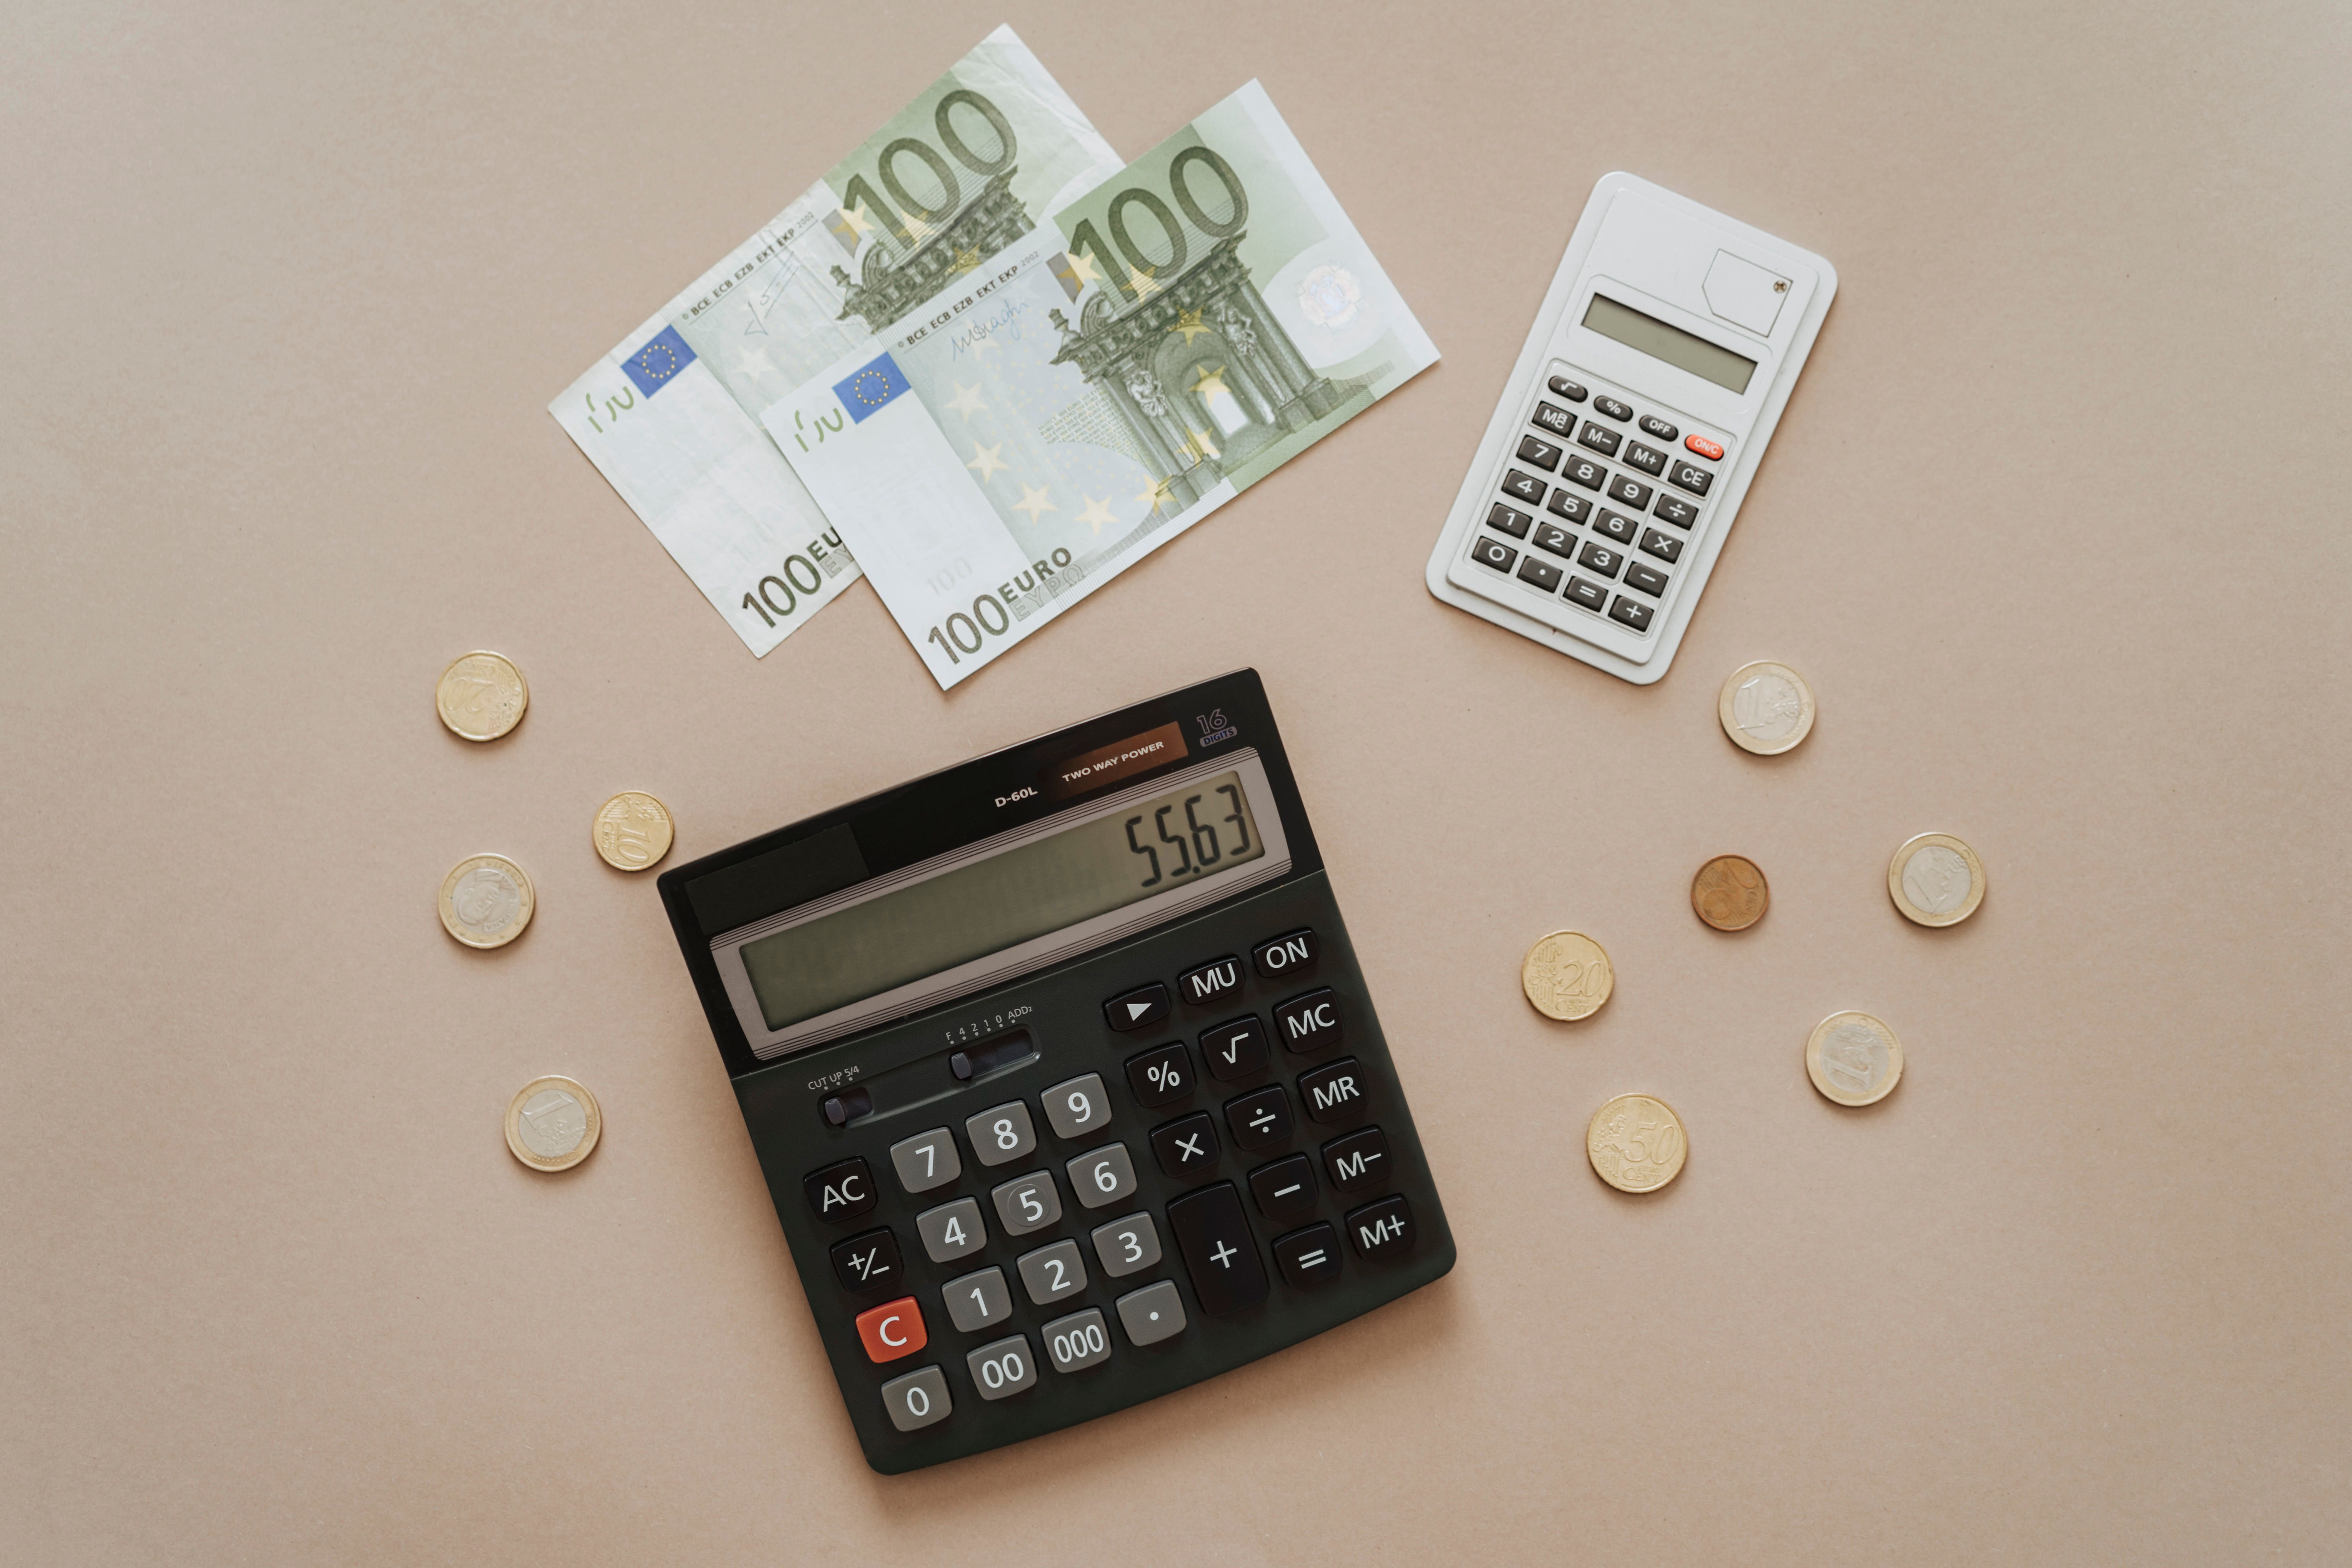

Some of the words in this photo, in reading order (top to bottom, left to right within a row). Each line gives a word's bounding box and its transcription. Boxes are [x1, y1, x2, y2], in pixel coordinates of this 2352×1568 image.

[843, 89, 1017, 250] 100
[1068, 145, 1249, 303] 100
[690, 297, 711, 316] BCE
[712, 279, 733, 298] ECB
[734, 263, 755, 281] EZB
[756, 245, 776, 263] EKT
[776, 228, 795, 247] EKP
[797, 211, 815, 229] 2002
[906, 327, 928, 345] BCE
[930, 311, 951, 330] ECB
[953, 296, 973, 314] EZB
[976, 281, 997, 298] EKT
[998, 265, 1018, 283] EKP
[1020, 250, 1039, 267] 2002
[1649, 419, 1671, 434] OFF
[1535, 444, 1549, 458] 7
[1694, 438, 1719, 455] ON/C
[1517, 480, 1532, 493] 4
[1577, 464, 1594, 479] 8
[1682, 468, 1704, 486] CE
[1563, 497, 1579, 513] 5
[1623, 483, 1639, 499] 9
[1507, 512, 1516, 526] 1
[1609, 517, 1625, 532] 6
[1548, 530, 1564, 548] 2
[1594, 550, 1611, 566] 3
[742, 554, 822, 628] 100
[928, 594, 1009, 664] 100
[997, 548, 1071, 604] EURO
[1196, 708, 1227, 735] 16
[1203, 728, 1234, 745] DIGITS
[1062, 767, 1091, 782] TWO
[1093, 757, 1118, 771] WAY
[1121, 741, 1164, 762] POWER
[995, 787, 1038, 808] D-60L
[617, 821, 651, 862] 10
[1125, 784, 1250, 888] 55.63
[1266, 937, 1308, 969] ON
[1191, 963, 1236, 997] MU
[1556, 960, 1606, 997] 20
[1287, 1003, 1335, 1038] MC
[1555, 1000, 1590, 1013] CENT
[946, 1032, 951, 1040] F
[971, 1023, 978, 1032] 2
[808, 1077, 828, 1090] CUT
[829, 1072, 842, 1082] UP
[844, 1065, 859, 1077] 5/4
[1313, 1076, 1360, 1109] MR
[1068, 1092, 1091, 1123] 9
[993, 1119, 1018, 1150] 8
[1624, 1122, 1679, 1165] 50
[915, 1145, 934, 1177] 7
[1094, 1161, 1117, 1192] 6
[823, 1175, 865, 1212] AC
[1019, 1189, 1043, 1221] 5
[944, 1216, 966, 1245] 4
[1359, 1215, 1405, 1249] M+
[1118, 1232, 1142, 1263] 3
[1044, 1259, 1071, 1291] 2
[970, 1288, 988, 1316] 1
[880, 1316, 907, 1347] C
[1054, 1325, 1103, 1363] 000
[982, 1353, 1024, 1388] 00
[907, 1387, 929, 1416] 0
